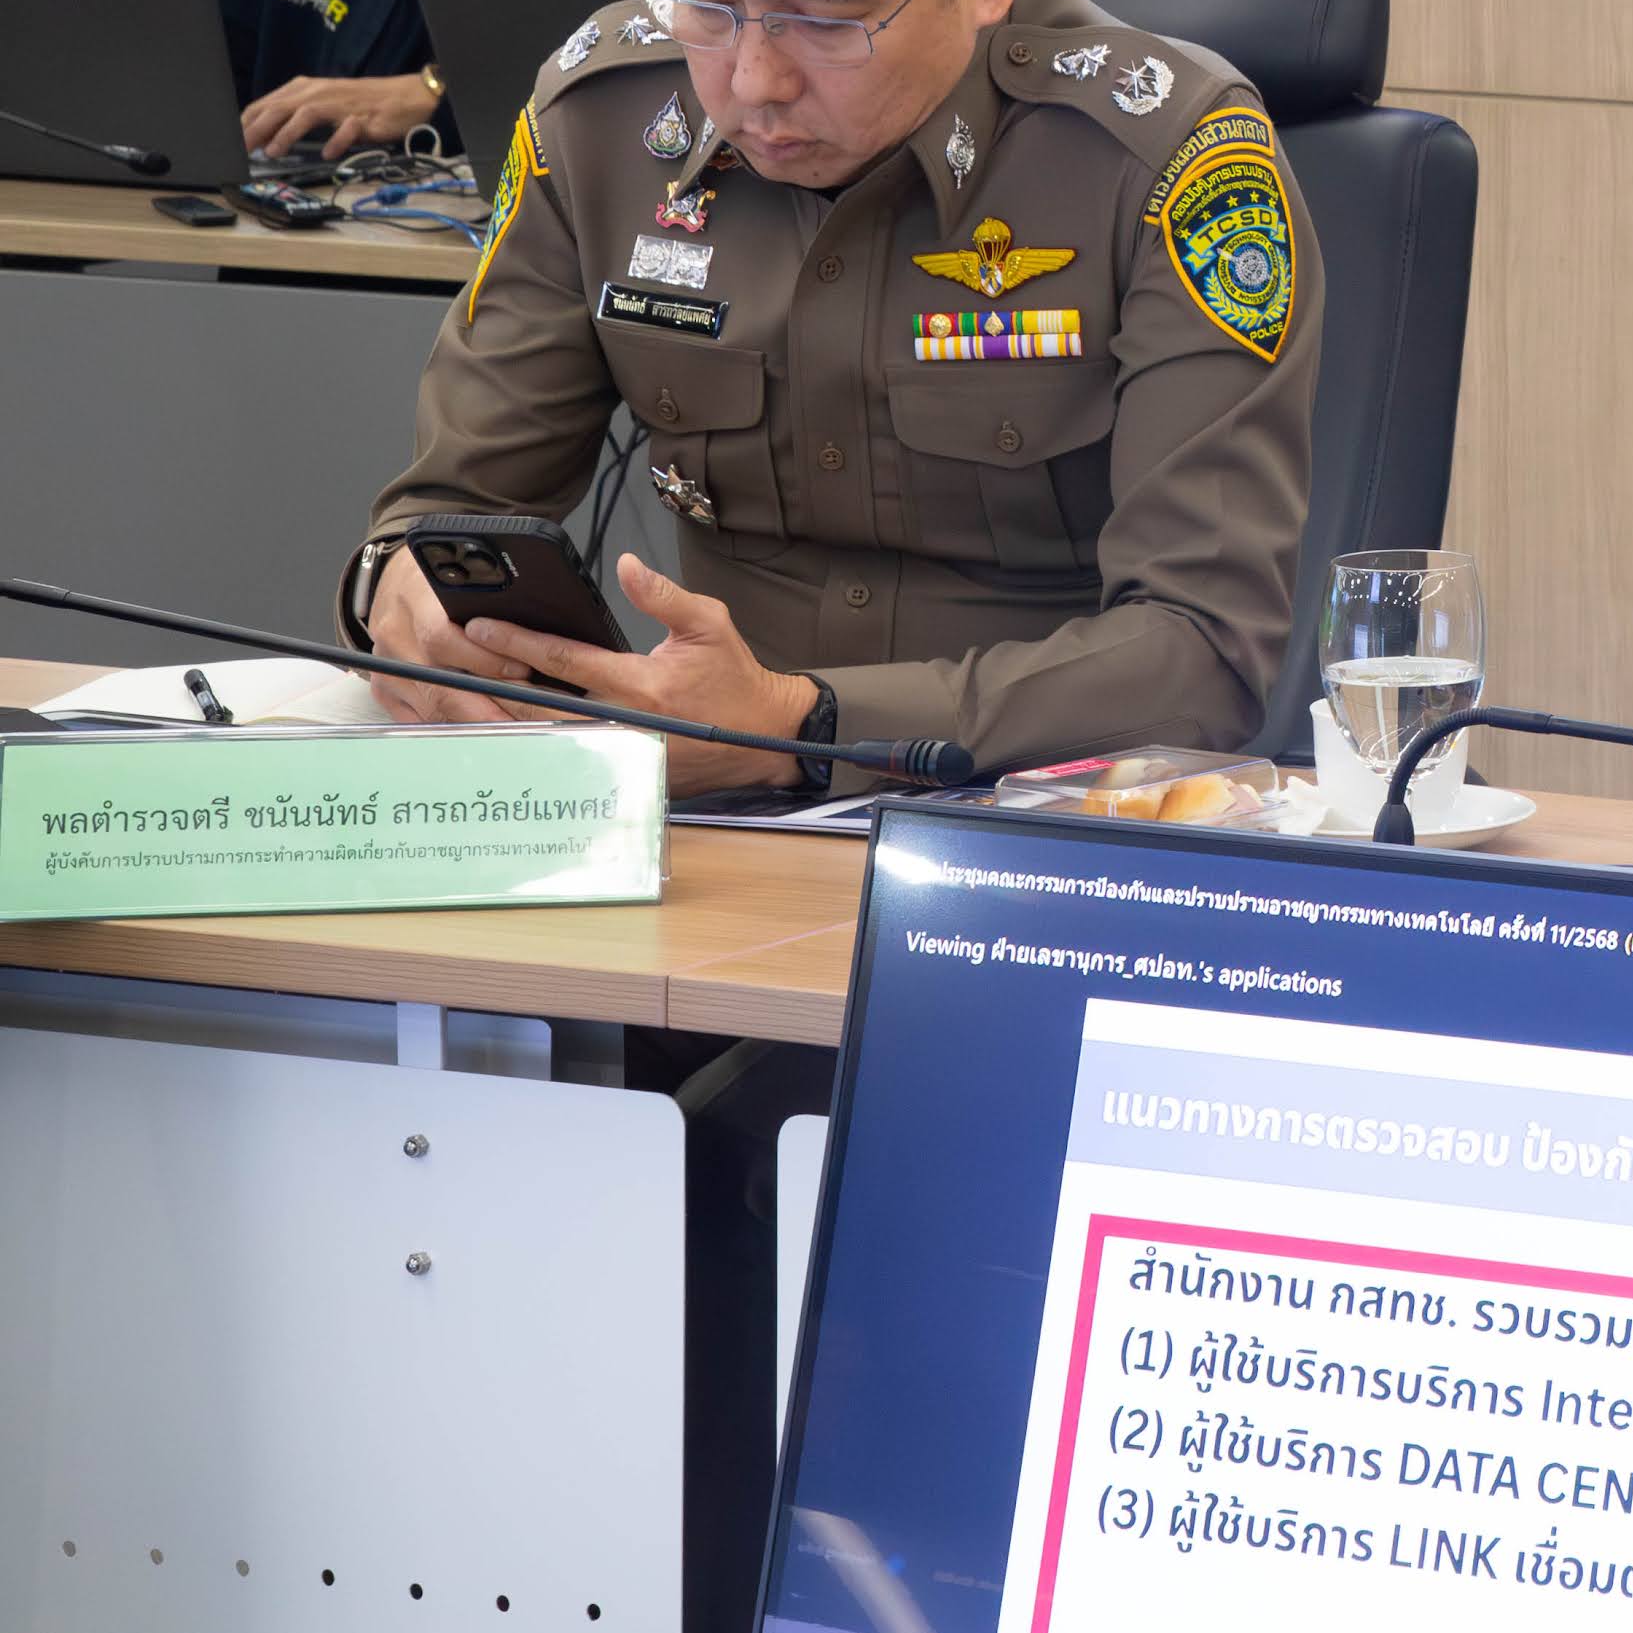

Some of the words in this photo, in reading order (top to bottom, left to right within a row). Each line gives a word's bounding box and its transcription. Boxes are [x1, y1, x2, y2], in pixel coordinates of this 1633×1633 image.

[1197, 209, 1275, 246] TCSD
[1249, 320, 1286, 343] POLICE
[41, 795, 231, 838] พลตำรวจตรี
[244, 790, 379, 830] ชนันนัทธ์
[905, 930, 986, 966] Viewing
[1217, 963, 1343, 999] applications
[1499, 913, 1546, 945] ครั้งที่
[1549, 923, 1619, 951] 11/2568
[1102, 1087, 1512, 1170] แนวทางการตรวจสอบ
[1129, 1245, 1314, 1313] สำนักงาน
[1329, 1285, 1458, 1330] กสทช.
[1119, 1325, 1174, 1380] (1)
[1189, 1329, 1524, 1418] ผู้ใช้บริการบริการ
[1107, 1404, 1165, 1459] (2)
[1178, 1409, 1384, 1481] ผู้ใช้บริการ
[1399, 1441, 1521, 1500] DATA
[1096, 1483, 1156, 1540] (3)
[1168, 1489, 1375, 1565] ผู้ใช้บริการ
[1390, 1524, 1503, 1582] LINK
